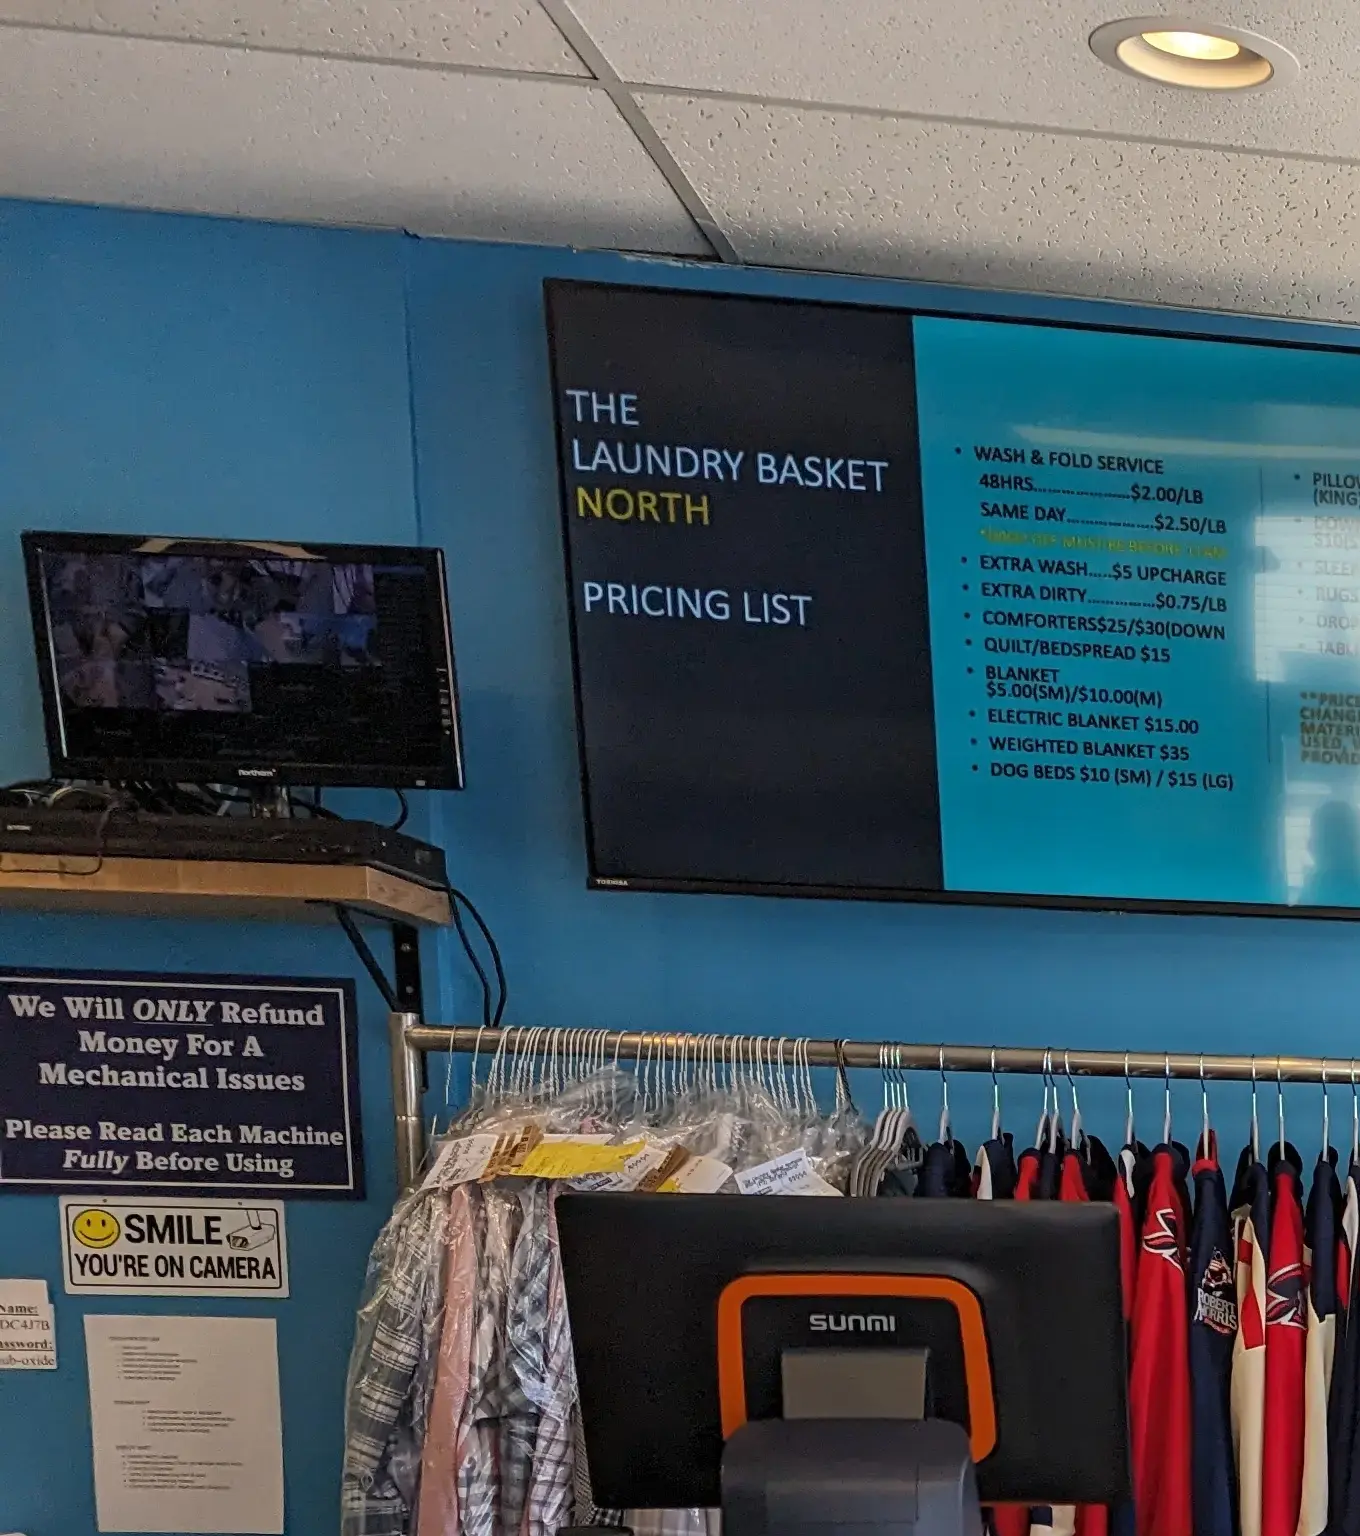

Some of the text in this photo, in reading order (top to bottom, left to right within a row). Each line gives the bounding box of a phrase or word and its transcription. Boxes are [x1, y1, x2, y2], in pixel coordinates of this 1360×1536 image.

[566, 389, 640, 426] THE
[573, 438, 889, 492] LAUNDRY BASKET
[974, 446, 1164, 475] WASH & FOLD SERVICE
[576, 487, 711, 526] NORTH
[980, 502, 1029, 520] SAME
[980, 555, 1034, 573] EXTRA
[1138, 567, 1227, 586] UPCHARGE
[583, 581, 813, 626] PRICING LIST
[981, 582, 1035, 600] EXTRA
[984, 637, 1171, 663] QUILT/BEDSPREAD $15
[985, 665, 1059, 683] BLANKET
[987, 708, 1199, 734] ELECTRIC BLANKET $15.00
[988, 736, 1190, 761] WEIGHTED BLANKET $35
[991, 762, 1028, 779] DOG
[1034, 764, 1075, 781] BEDS
[1080, 766, 1109, 784] $10
[1114, 768, 1151, 788] (SM)
[1168, 771, 1197, 788] $15
[1202, 772, 1234, 791] (LG)
[8, 994, 325, 1026] We Will ONLY Refund
[79, 1030, 264, 1061] Money For A
[38, 1062, 305, 1091] Mechanical Issues
[5, 1119, 344, 1146] Please Read Each Machine
[63, 1149, 294, 1178] Fully Before Using
[124, 1213, 223, 1245] SMILE
[74, 1253, 276, 1280] YOU'RE ON CAMERA
[1193, 1300, 1238, 1331] MORRIS
[1197, 1287, 1235, 1315] ROBERT
